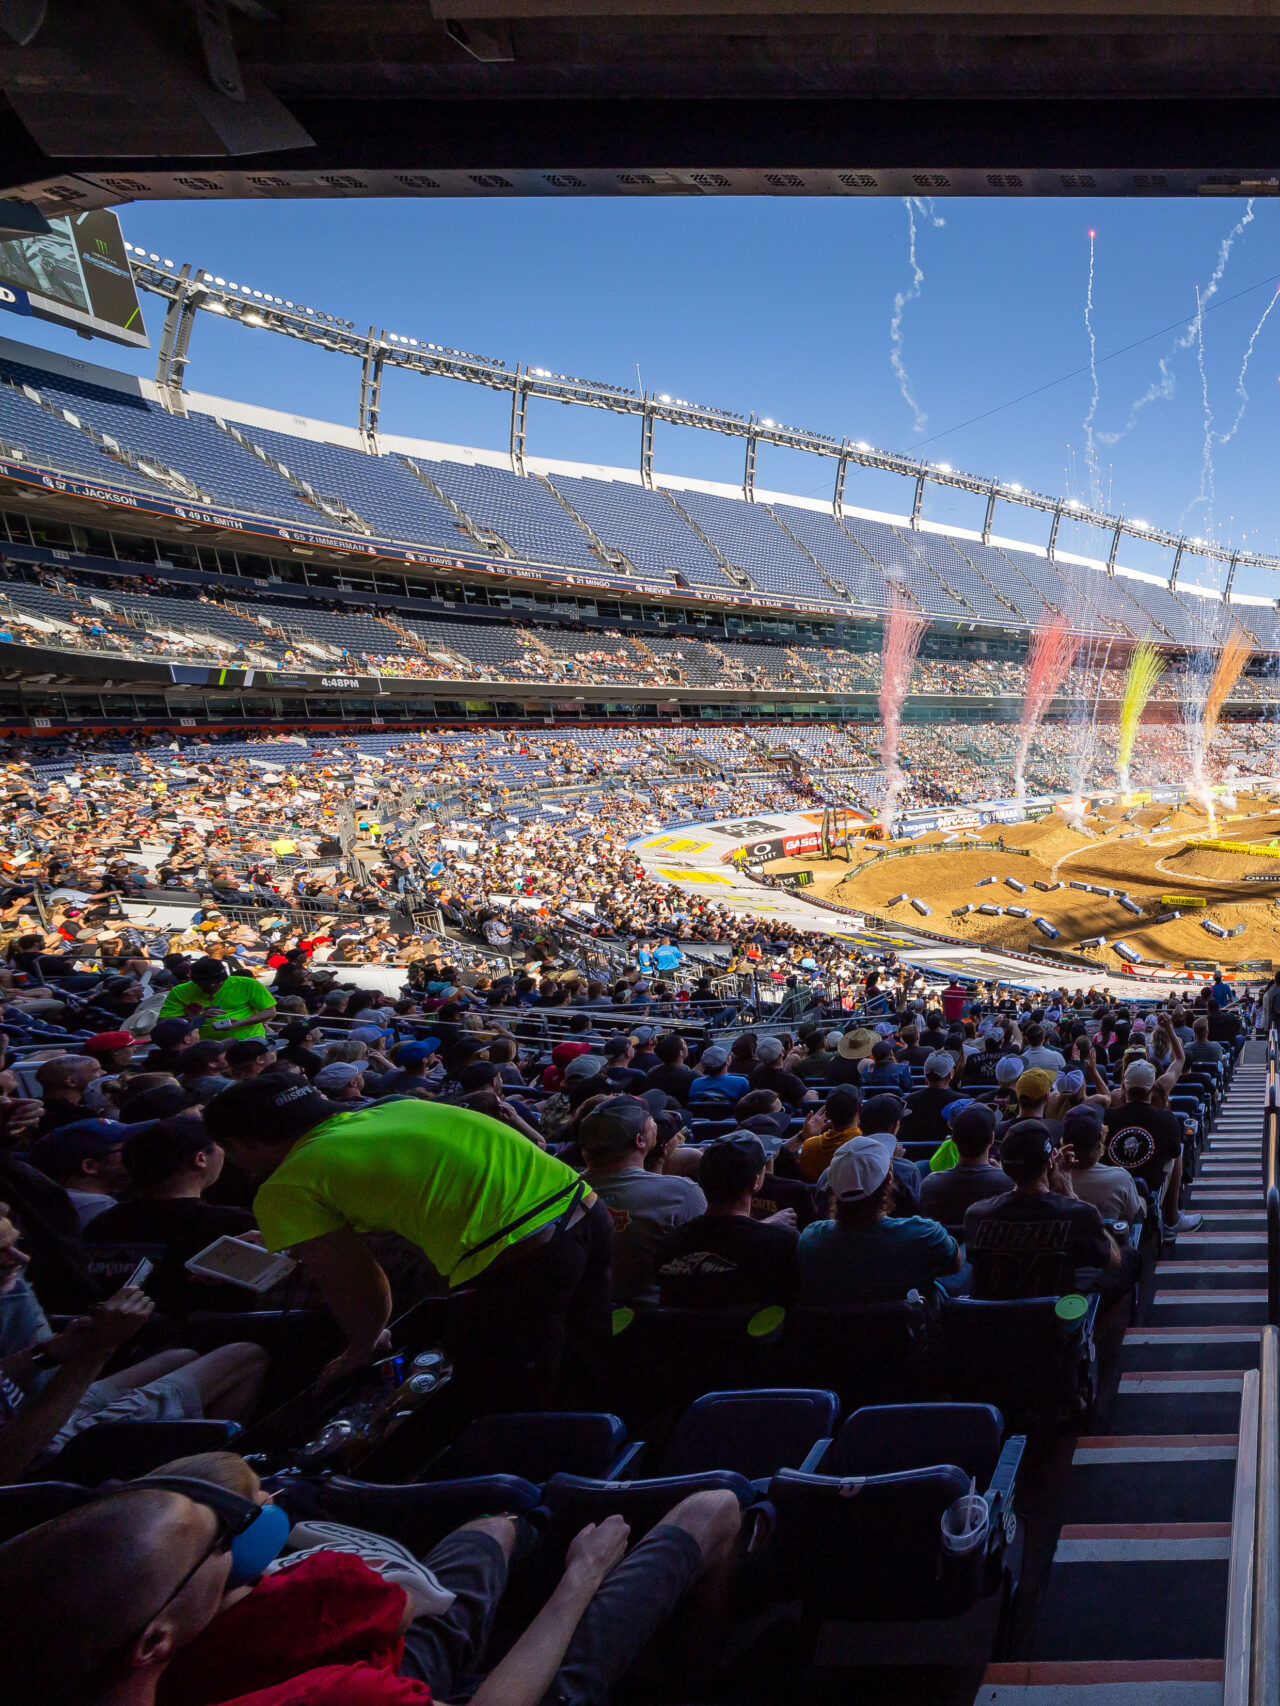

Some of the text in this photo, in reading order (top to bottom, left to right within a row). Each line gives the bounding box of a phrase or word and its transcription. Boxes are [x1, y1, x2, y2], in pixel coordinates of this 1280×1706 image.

[55, 480, 138, 507] 57 T. JACKSON
[188, 511, 201, 521] 49
[213, 515, 243, 530] SMITH
[293, 533, 365, 551] 65 ZIMMERMAN
[418, 554, 453, 567] 30 DAVIS
[516, 569, 542, 580] SMITH
[584, 578, 610, 588] MINGO
[644, 586, 670, 595] REEVES
[711, 594, 732, 602] LYNCH
[321, 677, 360, 688] 4:48PM
[36, 719, 49, 727] 117
[992, 809, 1019, 820] YAMAHA
[751, 1198, 779, 1213] ORTS
